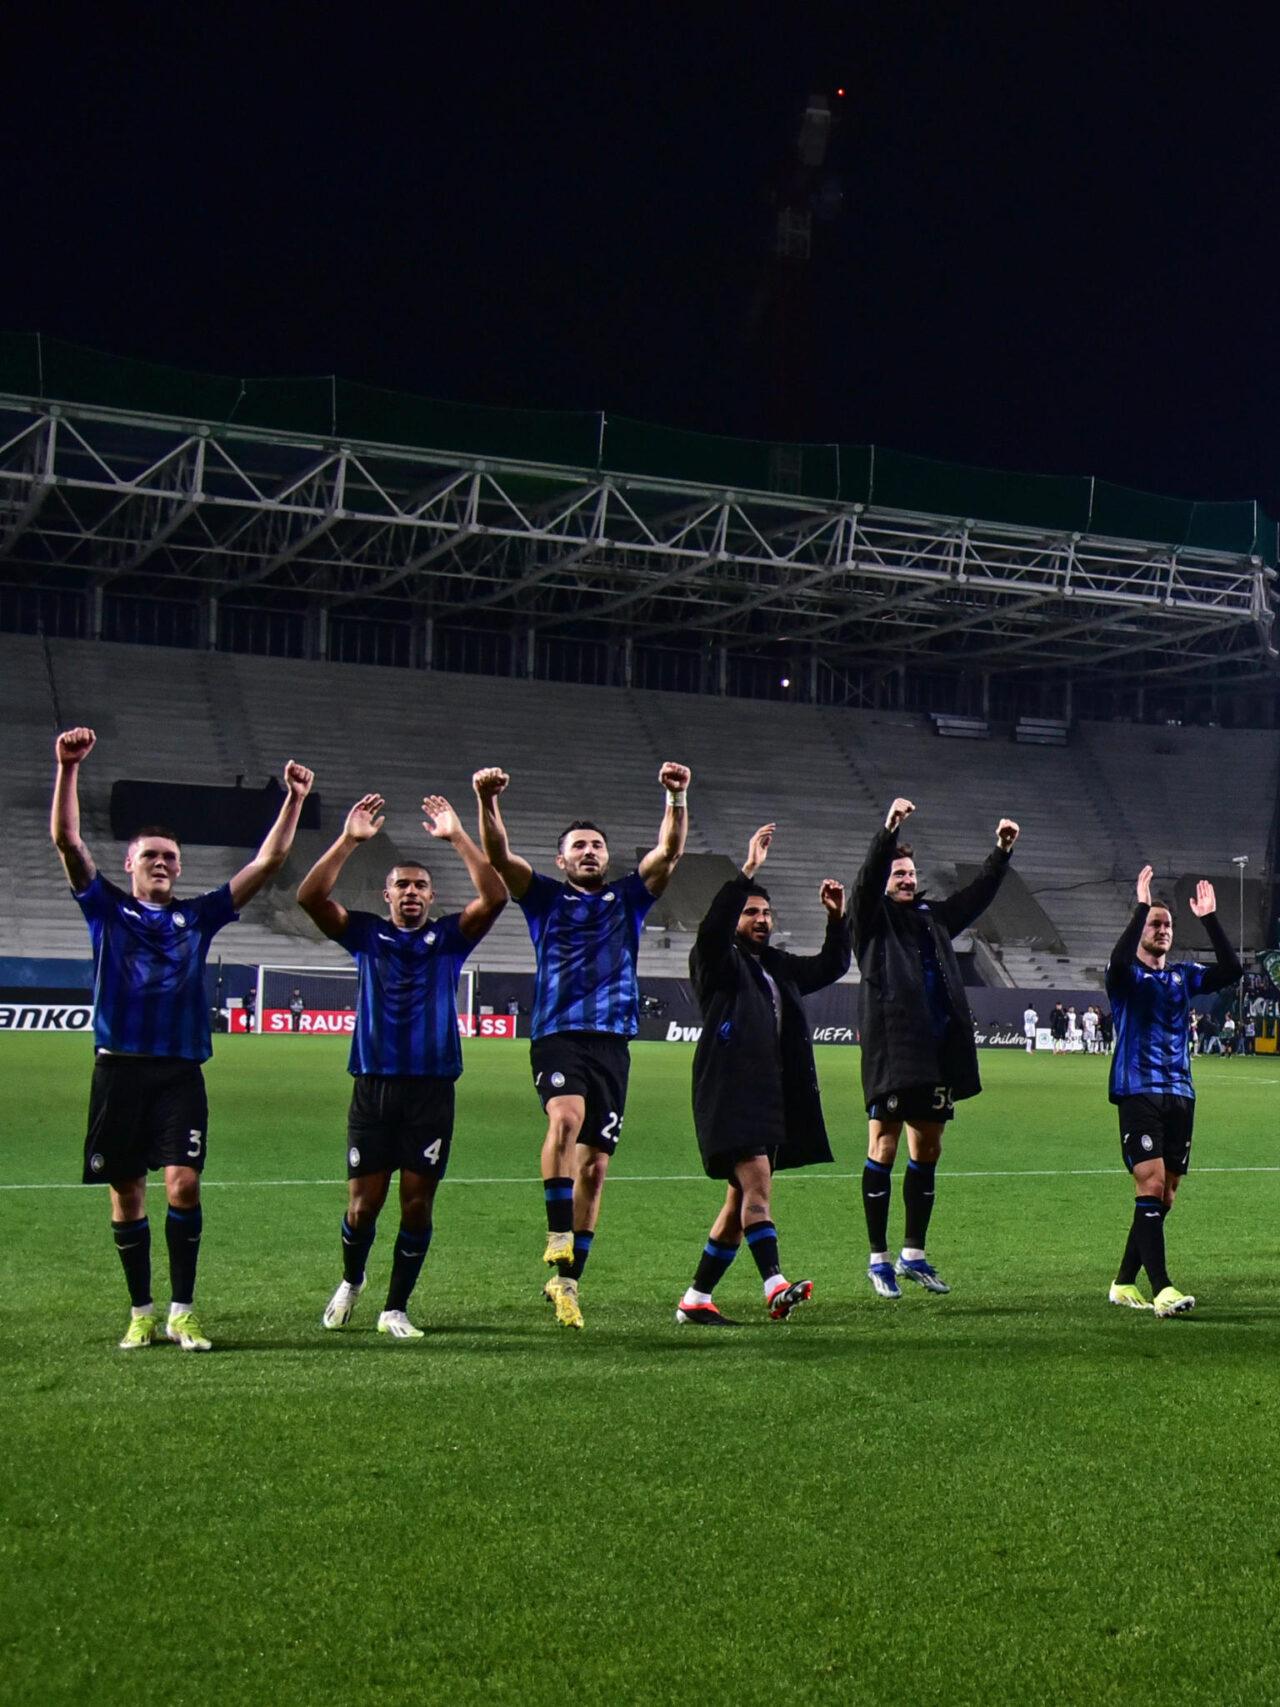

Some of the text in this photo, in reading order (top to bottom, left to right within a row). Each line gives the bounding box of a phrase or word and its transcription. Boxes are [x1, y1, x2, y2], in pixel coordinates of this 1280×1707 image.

[813, 1026, 853, 1041] UEFA
[187, 1129, 202, 1158] 3
[423, 1138, 442, 1166] 4
